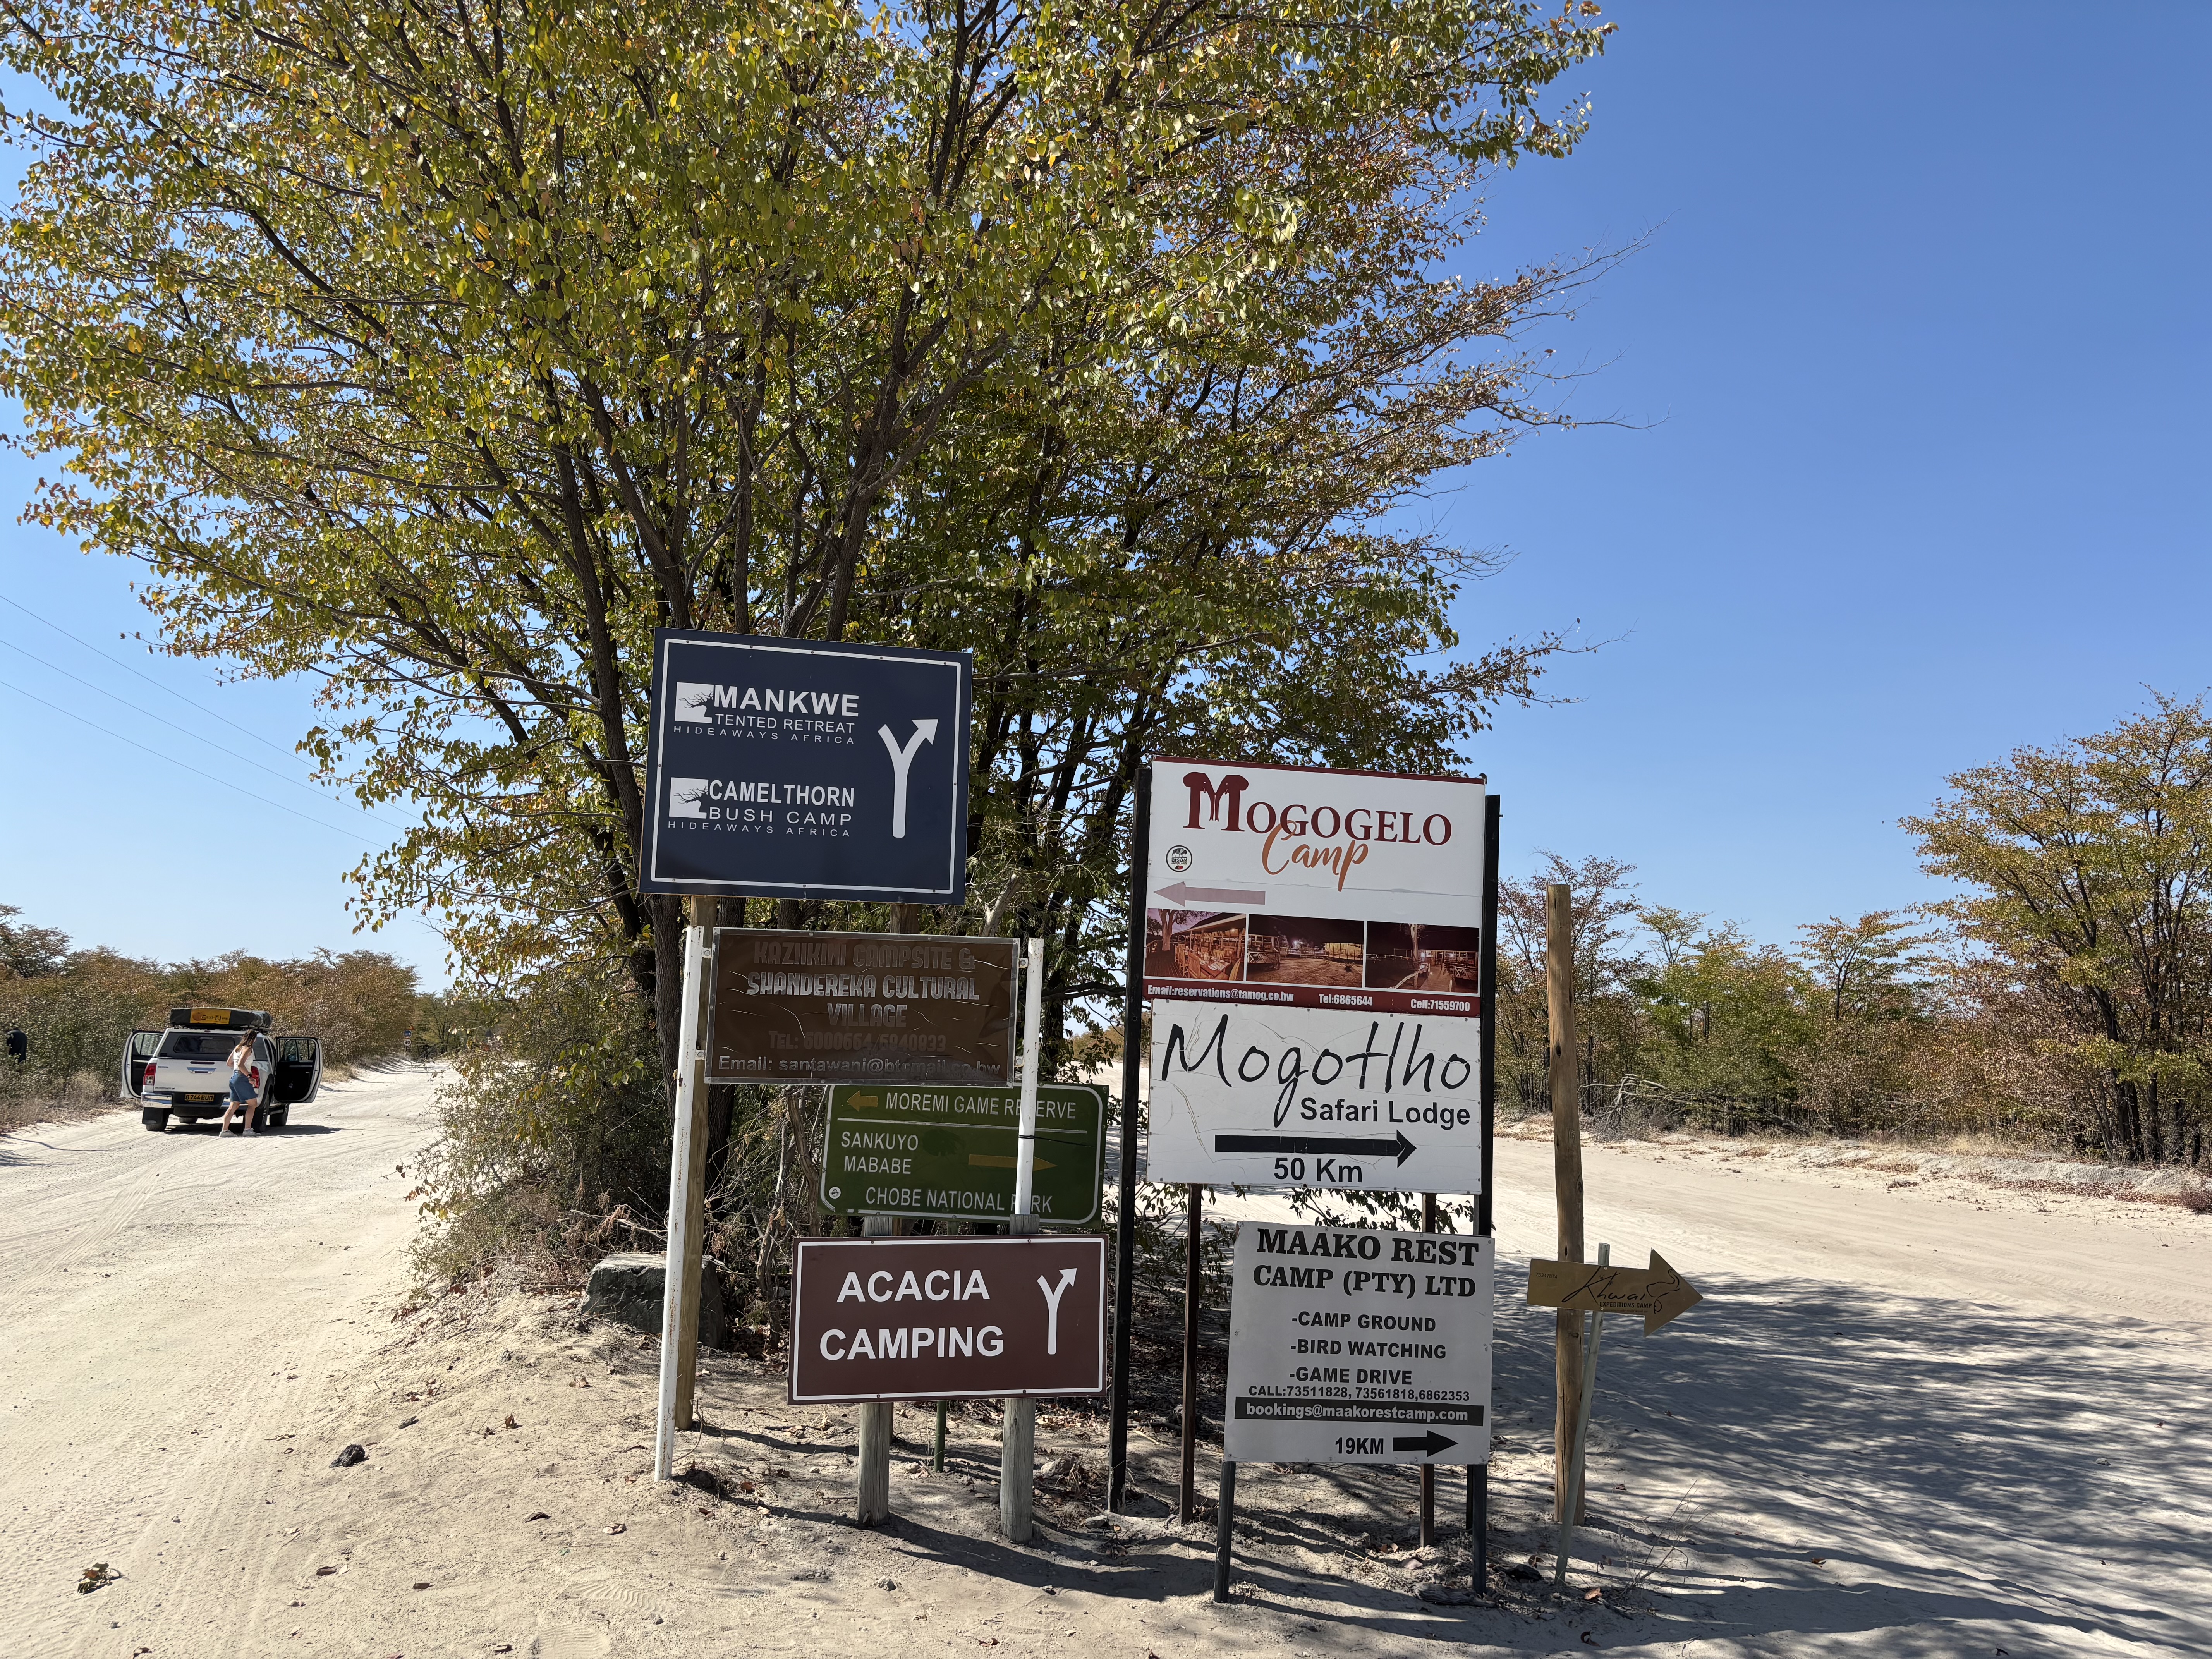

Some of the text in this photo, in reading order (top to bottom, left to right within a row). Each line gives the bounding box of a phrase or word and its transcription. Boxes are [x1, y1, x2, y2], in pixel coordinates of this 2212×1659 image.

[714, 685, 859, 717] MANKWE
[674, 726, 854, 744] HIDEAWAYS AFRICA
[715, 714, 855, 733] TENTED RETREAT
[709, 780, 854, 807] CAMELTHORN
[709, 807, 852, 826] BUSH CAMP
[1183, 772, 1452, 846] MOGOGELO
[668, 821, 850, 836] HIDEAWAYS AFRICA
[1262, 820, 1369, 891] Camp
[754, 941, 975, 969] KAZIIKINI CAMPSITE &
[747, 972, 979, 1000] SHANDEREKA CULTURAL
[1148, 985, 1470, 1012] Email:reservations@tamog.co.bw Tel:6865644 Cell:71559700
[828, 1003, 907, 1027] VILLAGE
[719, 1055, 771, 1070] Email:
[1162, 1014, 1470, 1128] Mogotlho
[886, 1092, 1076, 1119] MOREMI GAME REERVE
[1301, 1098, 1470, 1130] Safari Lodge
[841, 1132, 918, 1151] SANKUYO
[844, 1156, 911, 1174] MABABE
[1274, 1158, 1362, 1183] 50 Km
[866, 1187, 1053, 1213] CHOBE NATIONAL PRK
[1256, 1228, 1479, 1266] MAAKO REST
[837, 1270, 989, 1302] ACACIA
[1253, 1265, 1476, 1299] CAMP (PTY) LTD
[1292, 1311, 1436, 1331] -CAMP GROUND
[820, 1326, 1003, 1360] CAMPING
[1291, 1339, 1446, 1359] -BIRD WATCHING
[1289, 1367, 1412, 1385] -GAME DRIVE
[1246, 1403, 1468, 1422] bookings@maakorestcamp.com
[1335, 1437, 1384, 1455] 19KM
